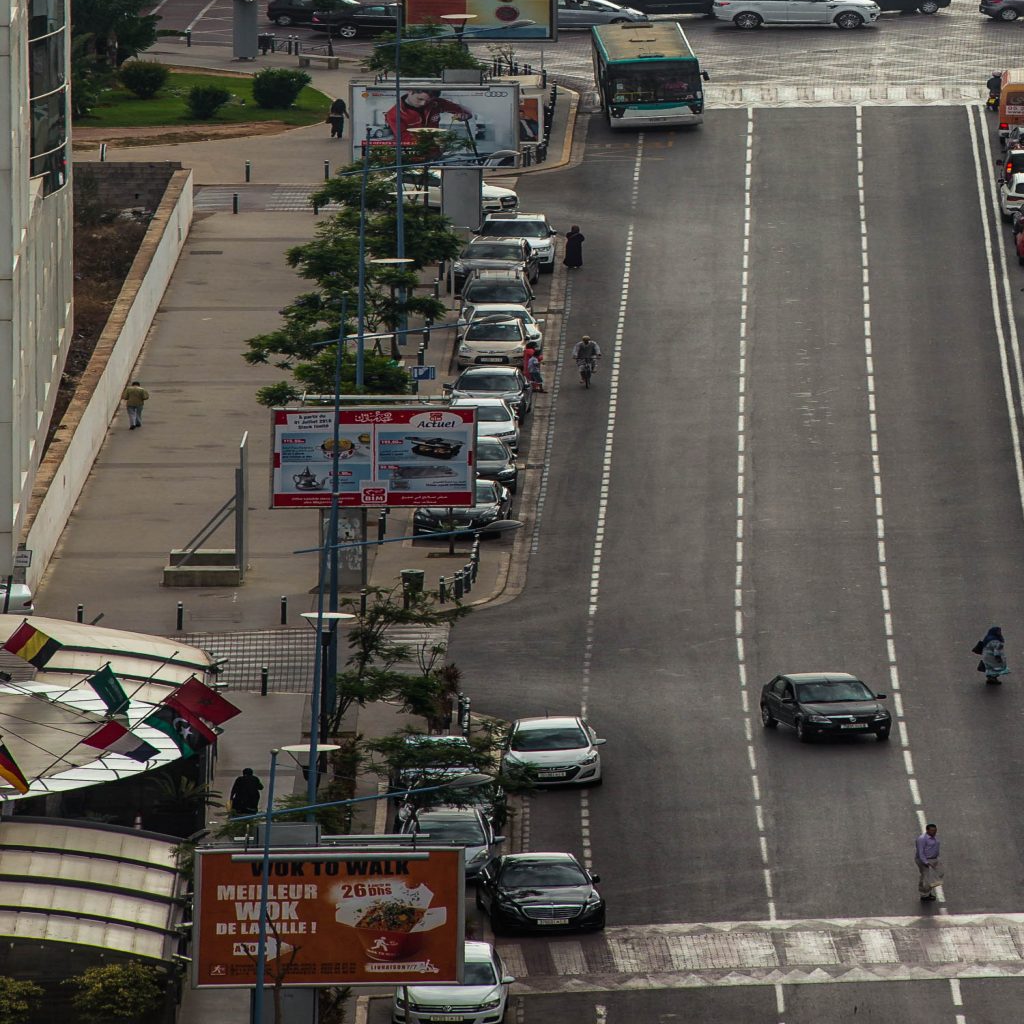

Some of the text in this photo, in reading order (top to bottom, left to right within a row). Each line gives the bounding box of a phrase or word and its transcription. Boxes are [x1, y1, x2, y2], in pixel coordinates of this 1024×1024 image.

[417, 420, 456, 428] Actuel
[251, 861, 409, 877] WOK TO WALK
[217, 884, 318, 900] MEILLEUR
[341, 883, 366, 899] 26
[234, 900, 299, 921] WOK
[216, 922, 237, 935] DE
[240, 922, 260, 935] LA
